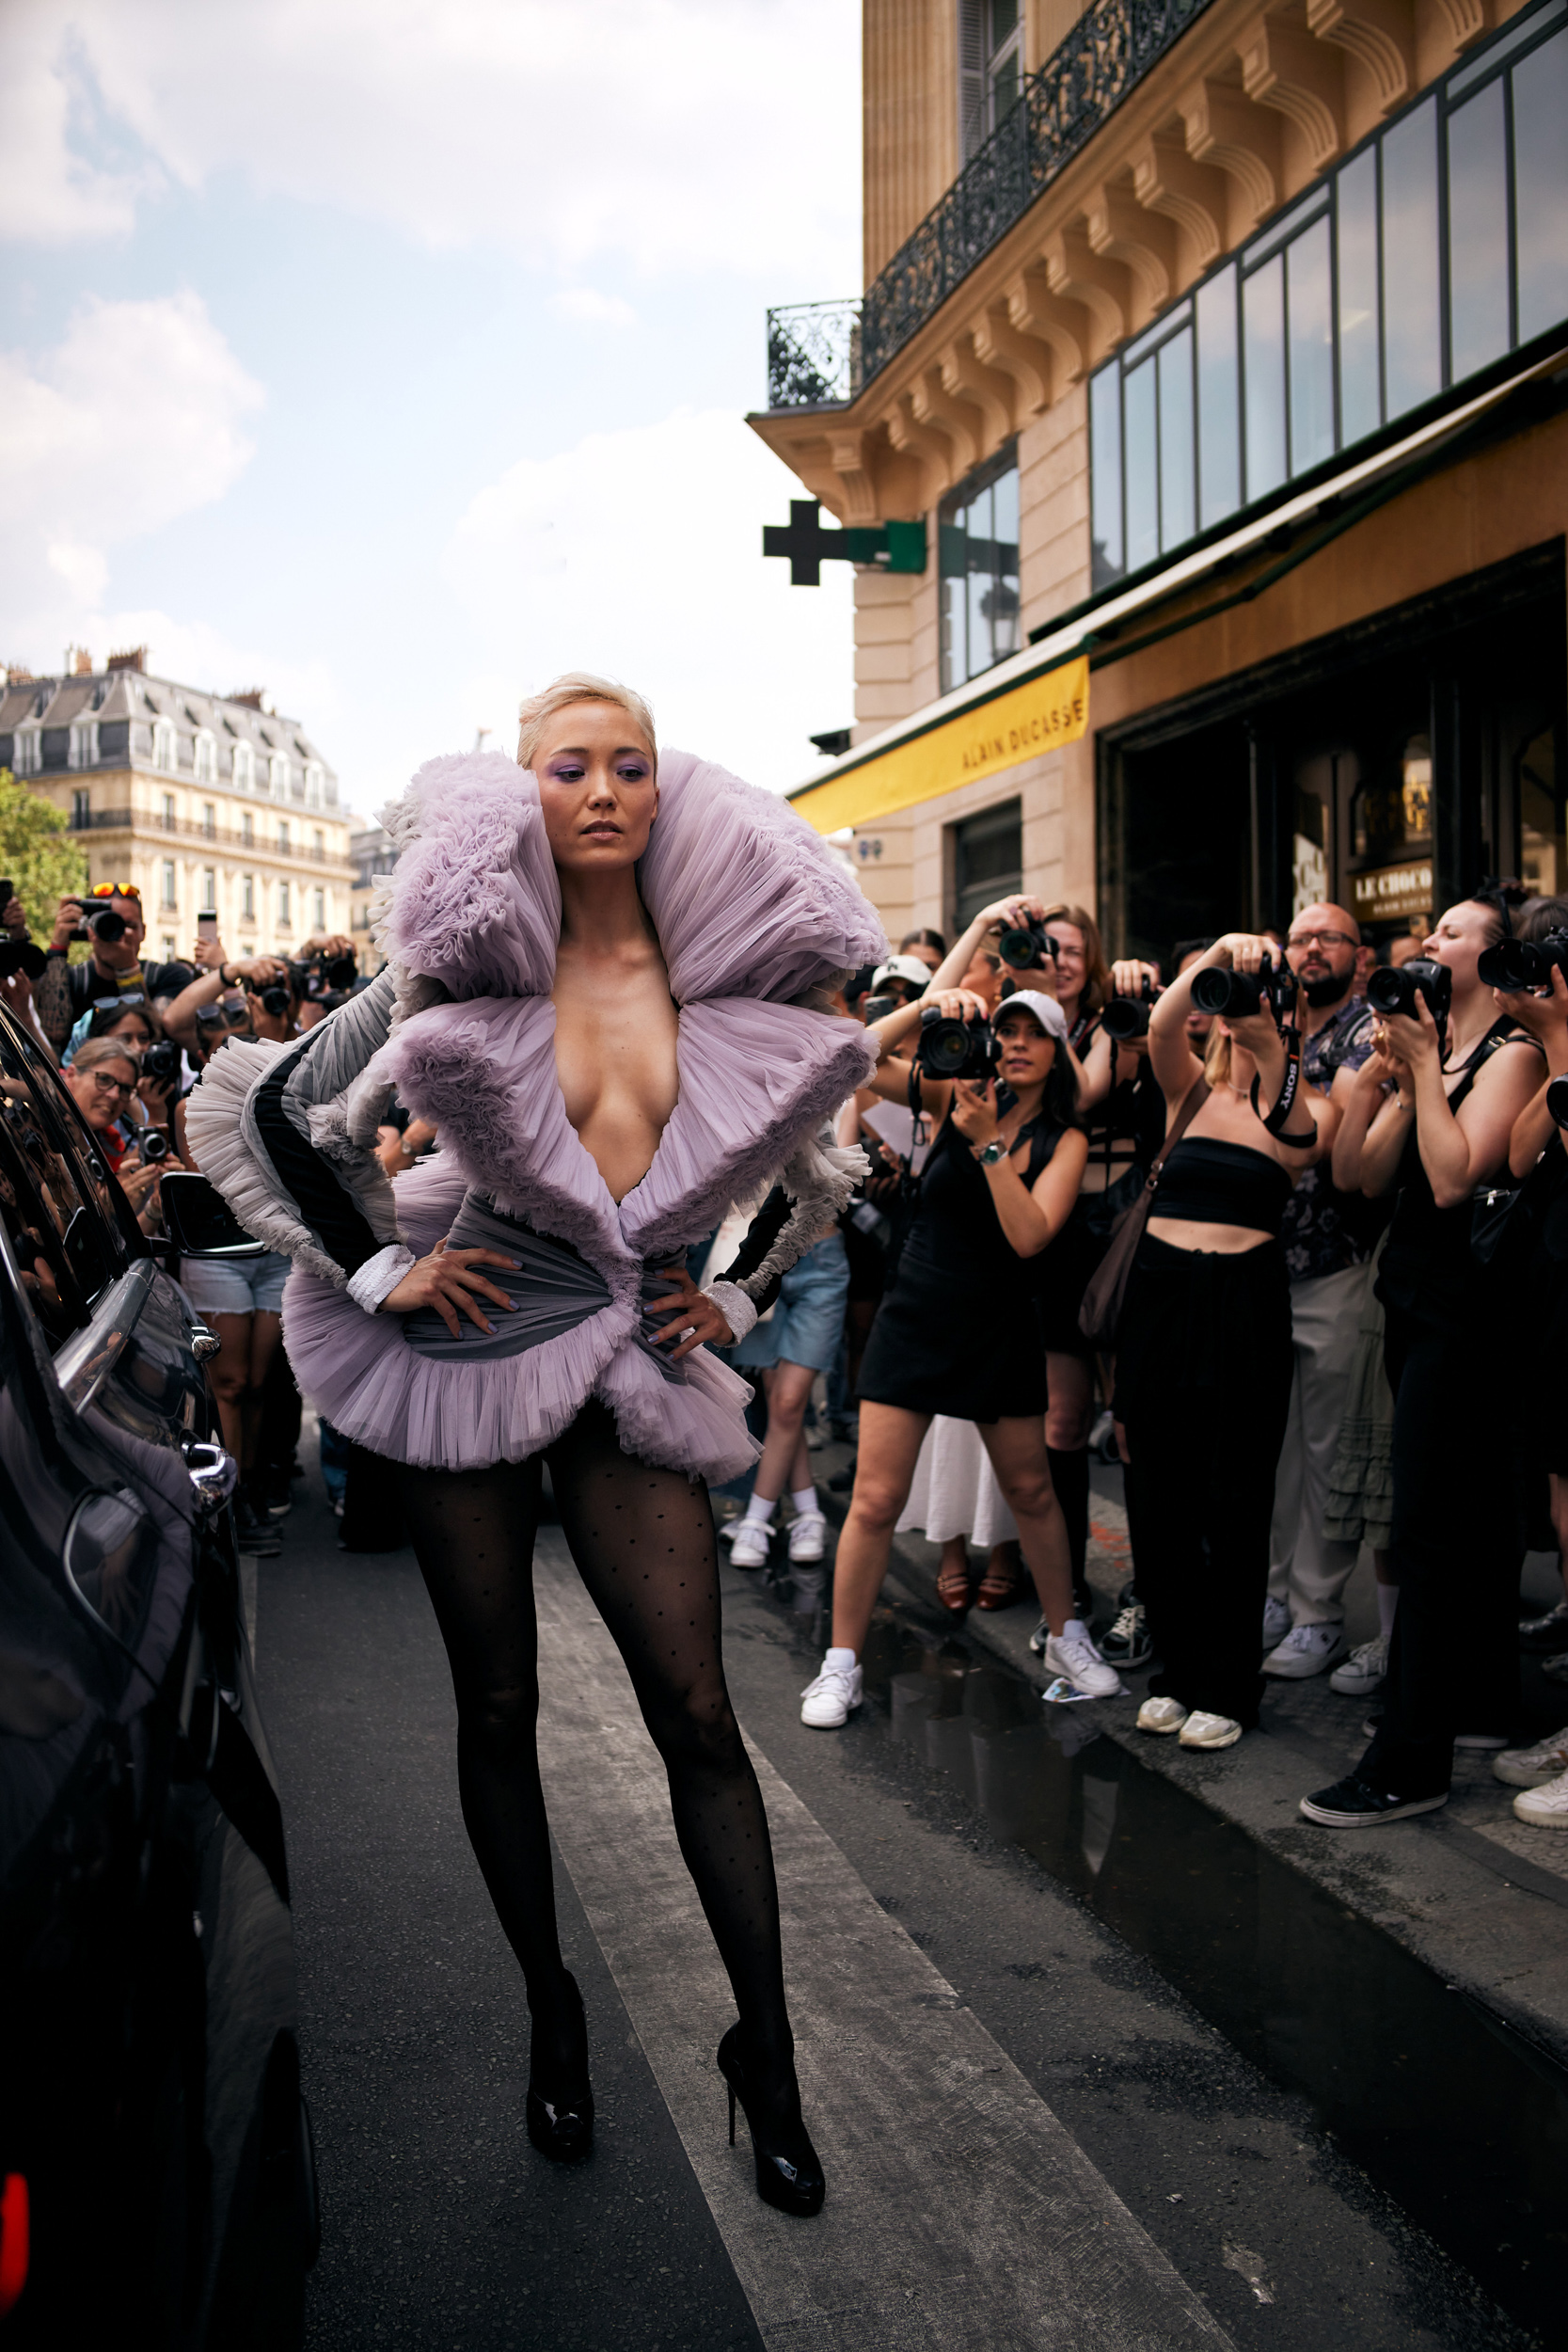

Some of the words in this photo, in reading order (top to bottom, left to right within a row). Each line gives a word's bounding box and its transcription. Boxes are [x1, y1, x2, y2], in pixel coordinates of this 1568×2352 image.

[961, 736, 1004, 769] ALAIN
[1009, 699, 1083, 752] DUCASSE
[1355, 877, 1377, 901] LE
[1280, 1063, 1297, 1109] SONY
